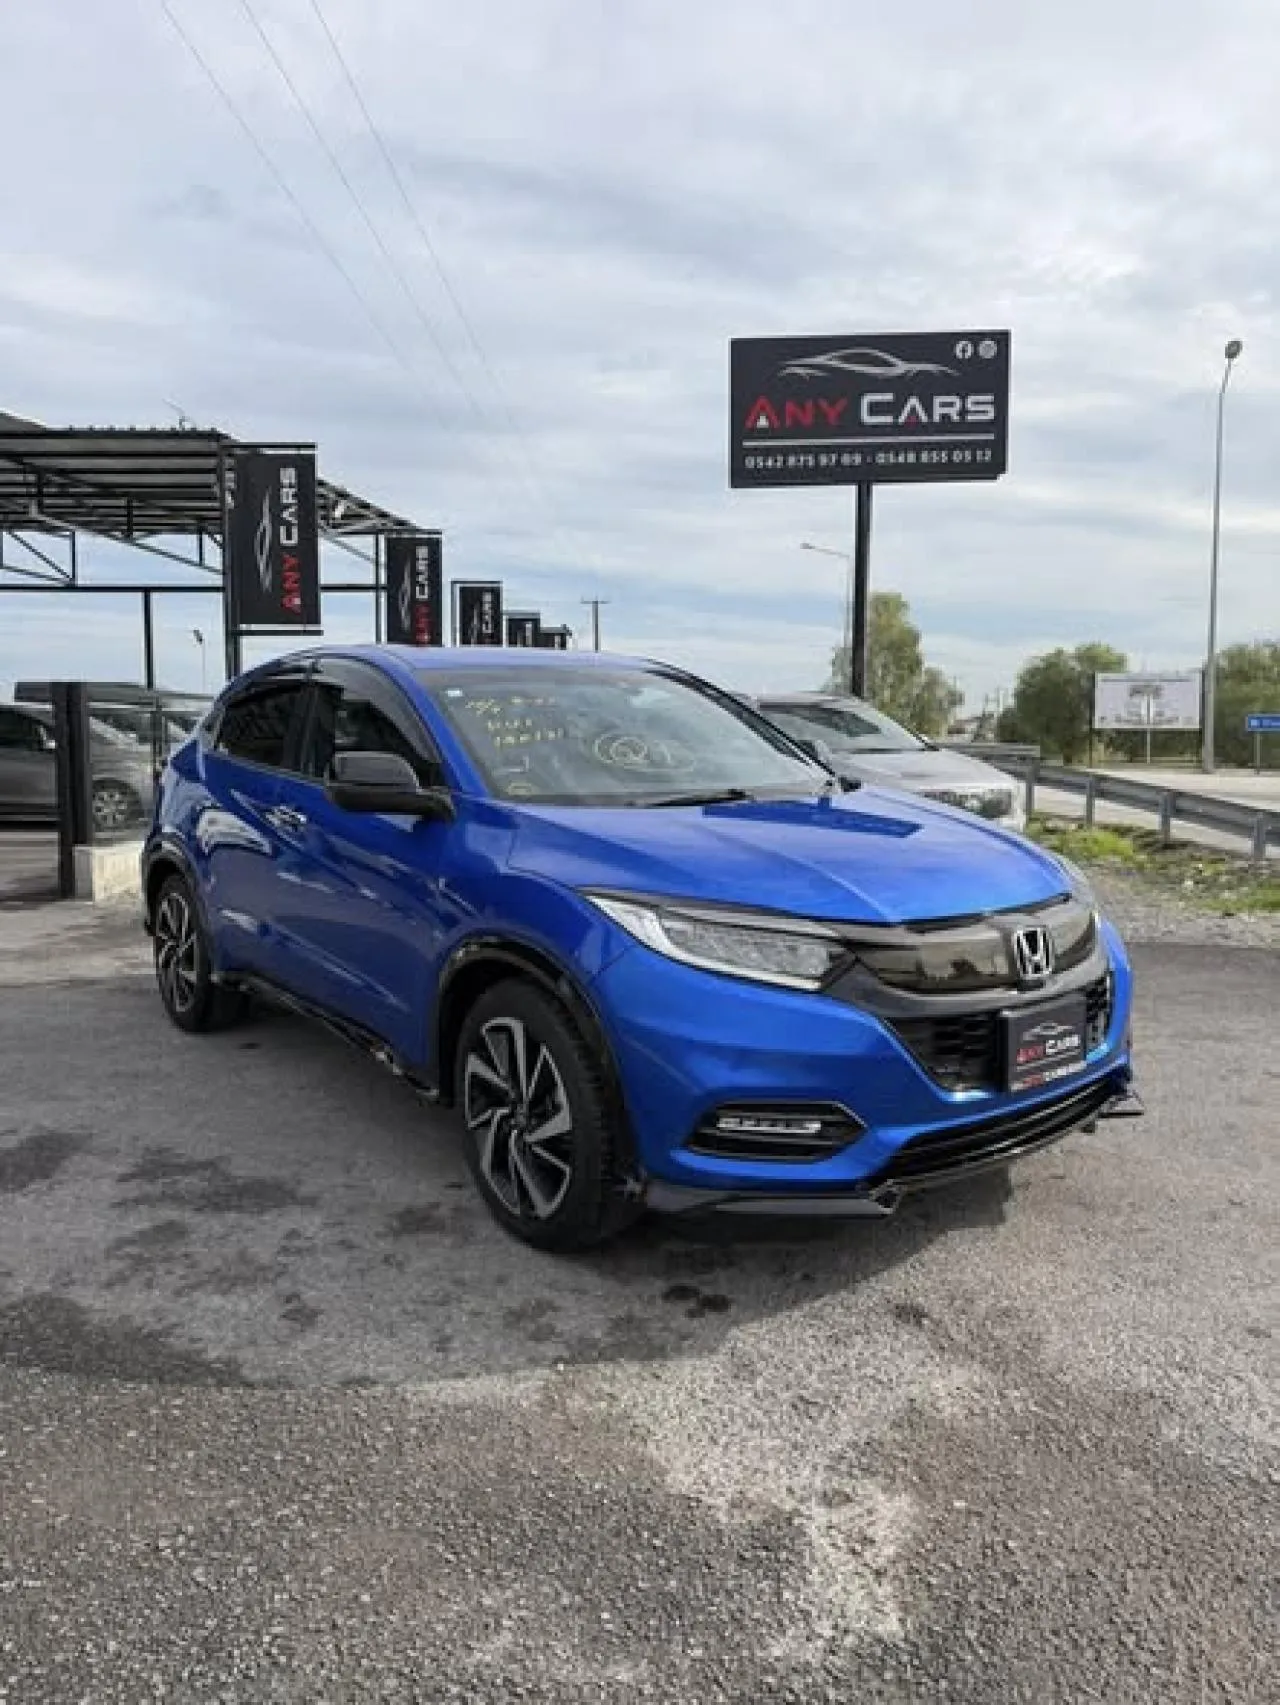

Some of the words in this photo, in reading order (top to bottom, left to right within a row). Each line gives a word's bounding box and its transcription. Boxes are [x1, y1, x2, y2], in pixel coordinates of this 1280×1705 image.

[744, 394, 849, 430] ANY
[860, 392, 995, 426] CARS
[279, 467, 299, 547] CARS
[281, 551, 301, 614] ANY
